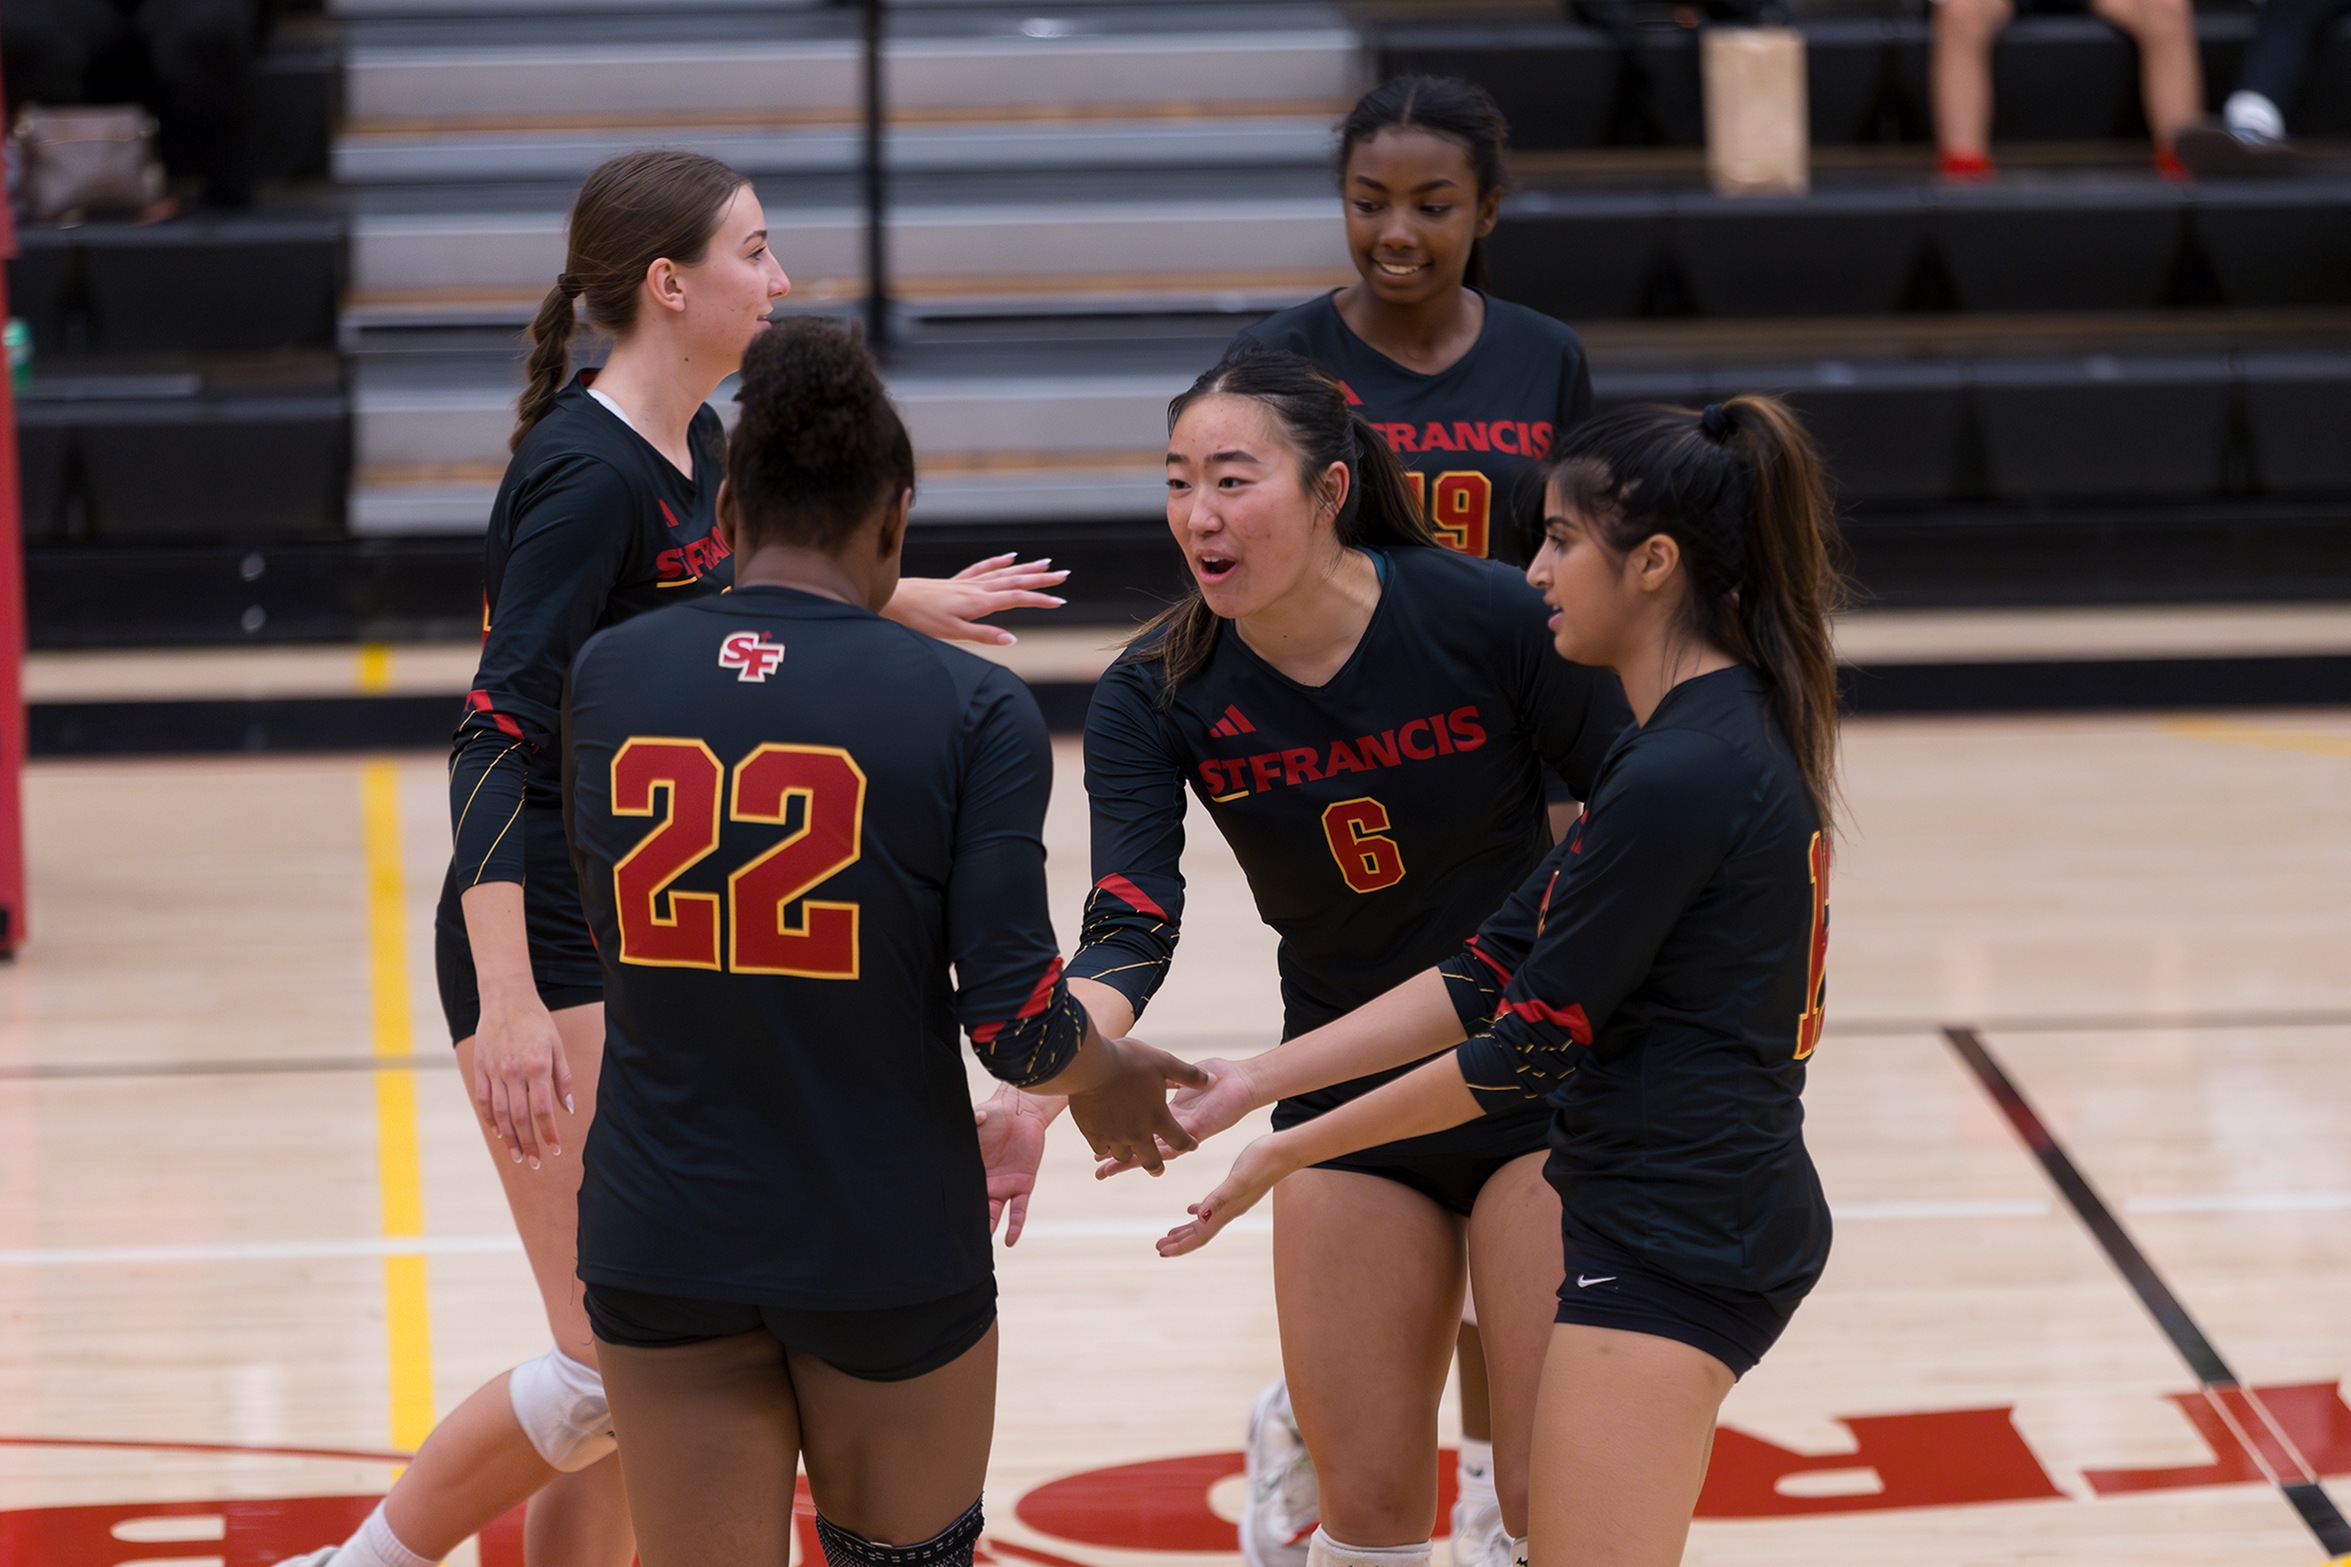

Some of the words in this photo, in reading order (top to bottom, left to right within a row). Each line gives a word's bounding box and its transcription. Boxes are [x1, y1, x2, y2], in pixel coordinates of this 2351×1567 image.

[718, 630, 786, 683] SF
[610, 735, 868, 980] 22
[1321, 795, 1407, 894] 6
